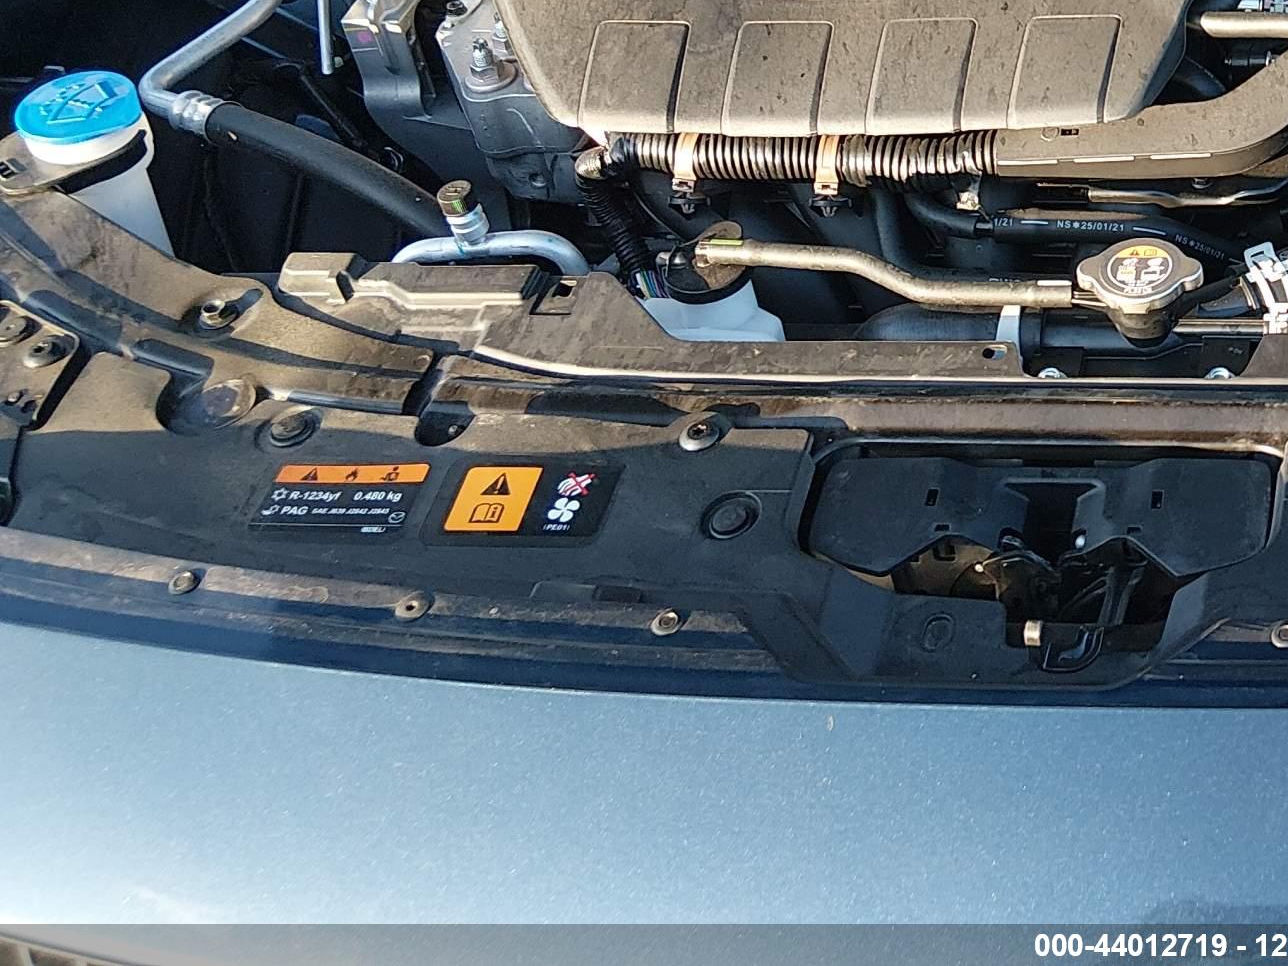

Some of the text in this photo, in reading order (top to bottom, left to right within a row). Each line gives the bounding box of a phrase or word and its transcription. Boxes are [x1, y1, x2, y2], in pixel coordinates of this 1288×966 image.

[289, 491, 402, 502] R-1234yf 0.480 kg
[280, 505, 308, 514] PAG
